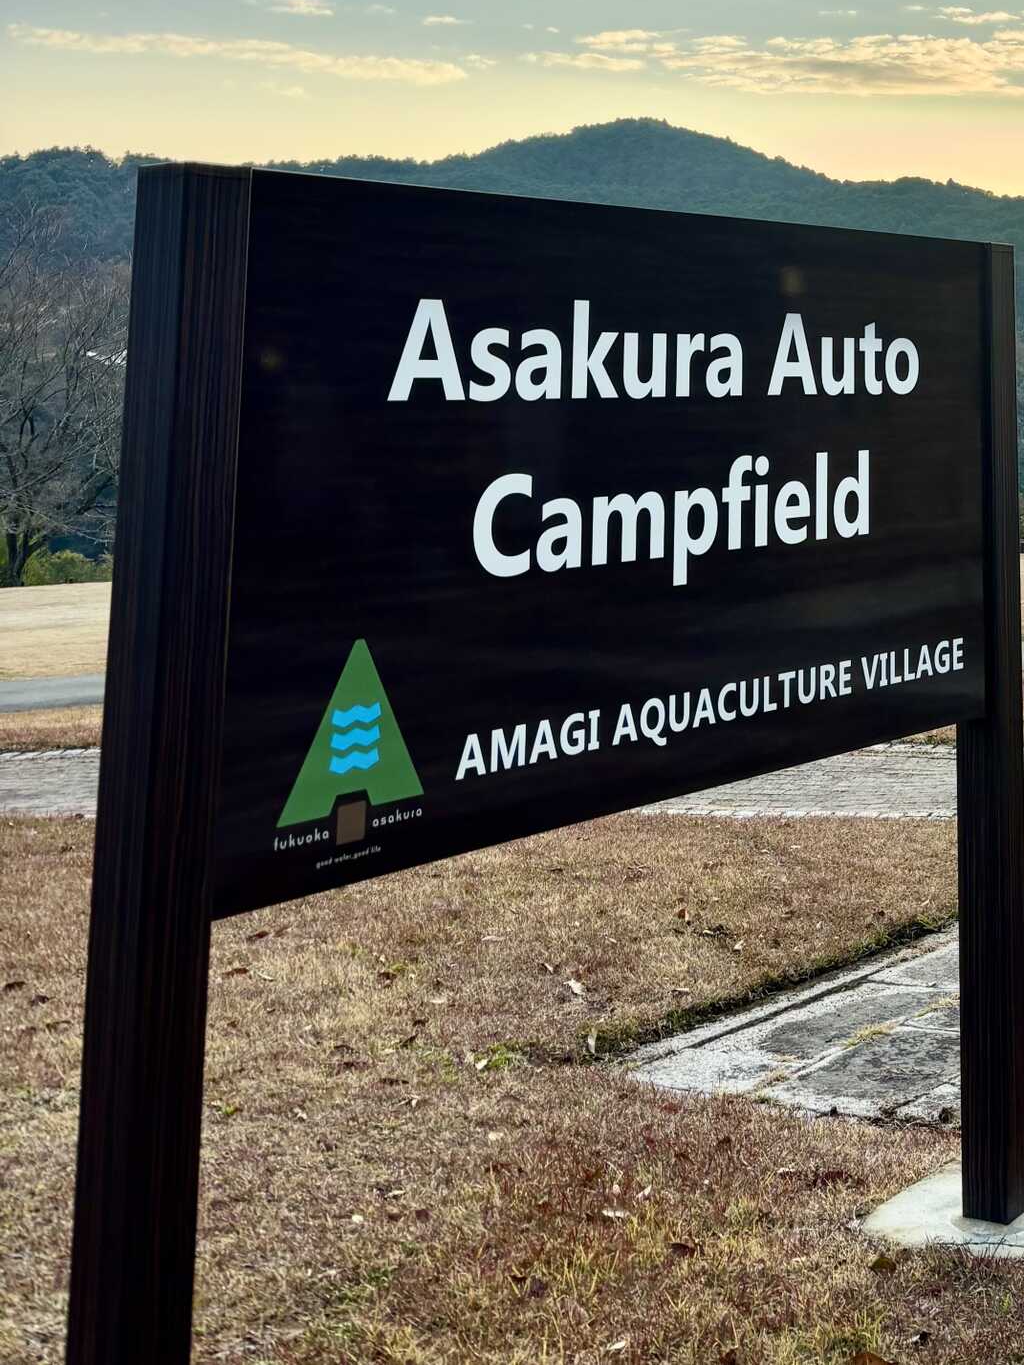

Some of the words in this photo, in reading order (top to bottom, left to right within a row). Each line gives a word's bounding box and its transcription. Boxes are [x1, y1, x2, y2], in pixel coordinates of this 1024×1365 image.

[387, 298, 743, 402] Asakura
[767, 312, 920, 396] Auto
[472, 449, 870, 587] Campfield
[455, 709, 601, 781] AMAGI
[612, 659, 852, 747] AQUACULTURE
[860, 637, 965, 690] VILLAGE
[273, 827, 330, 851] fukuoka
[372, 808, 423, 828] asakura
